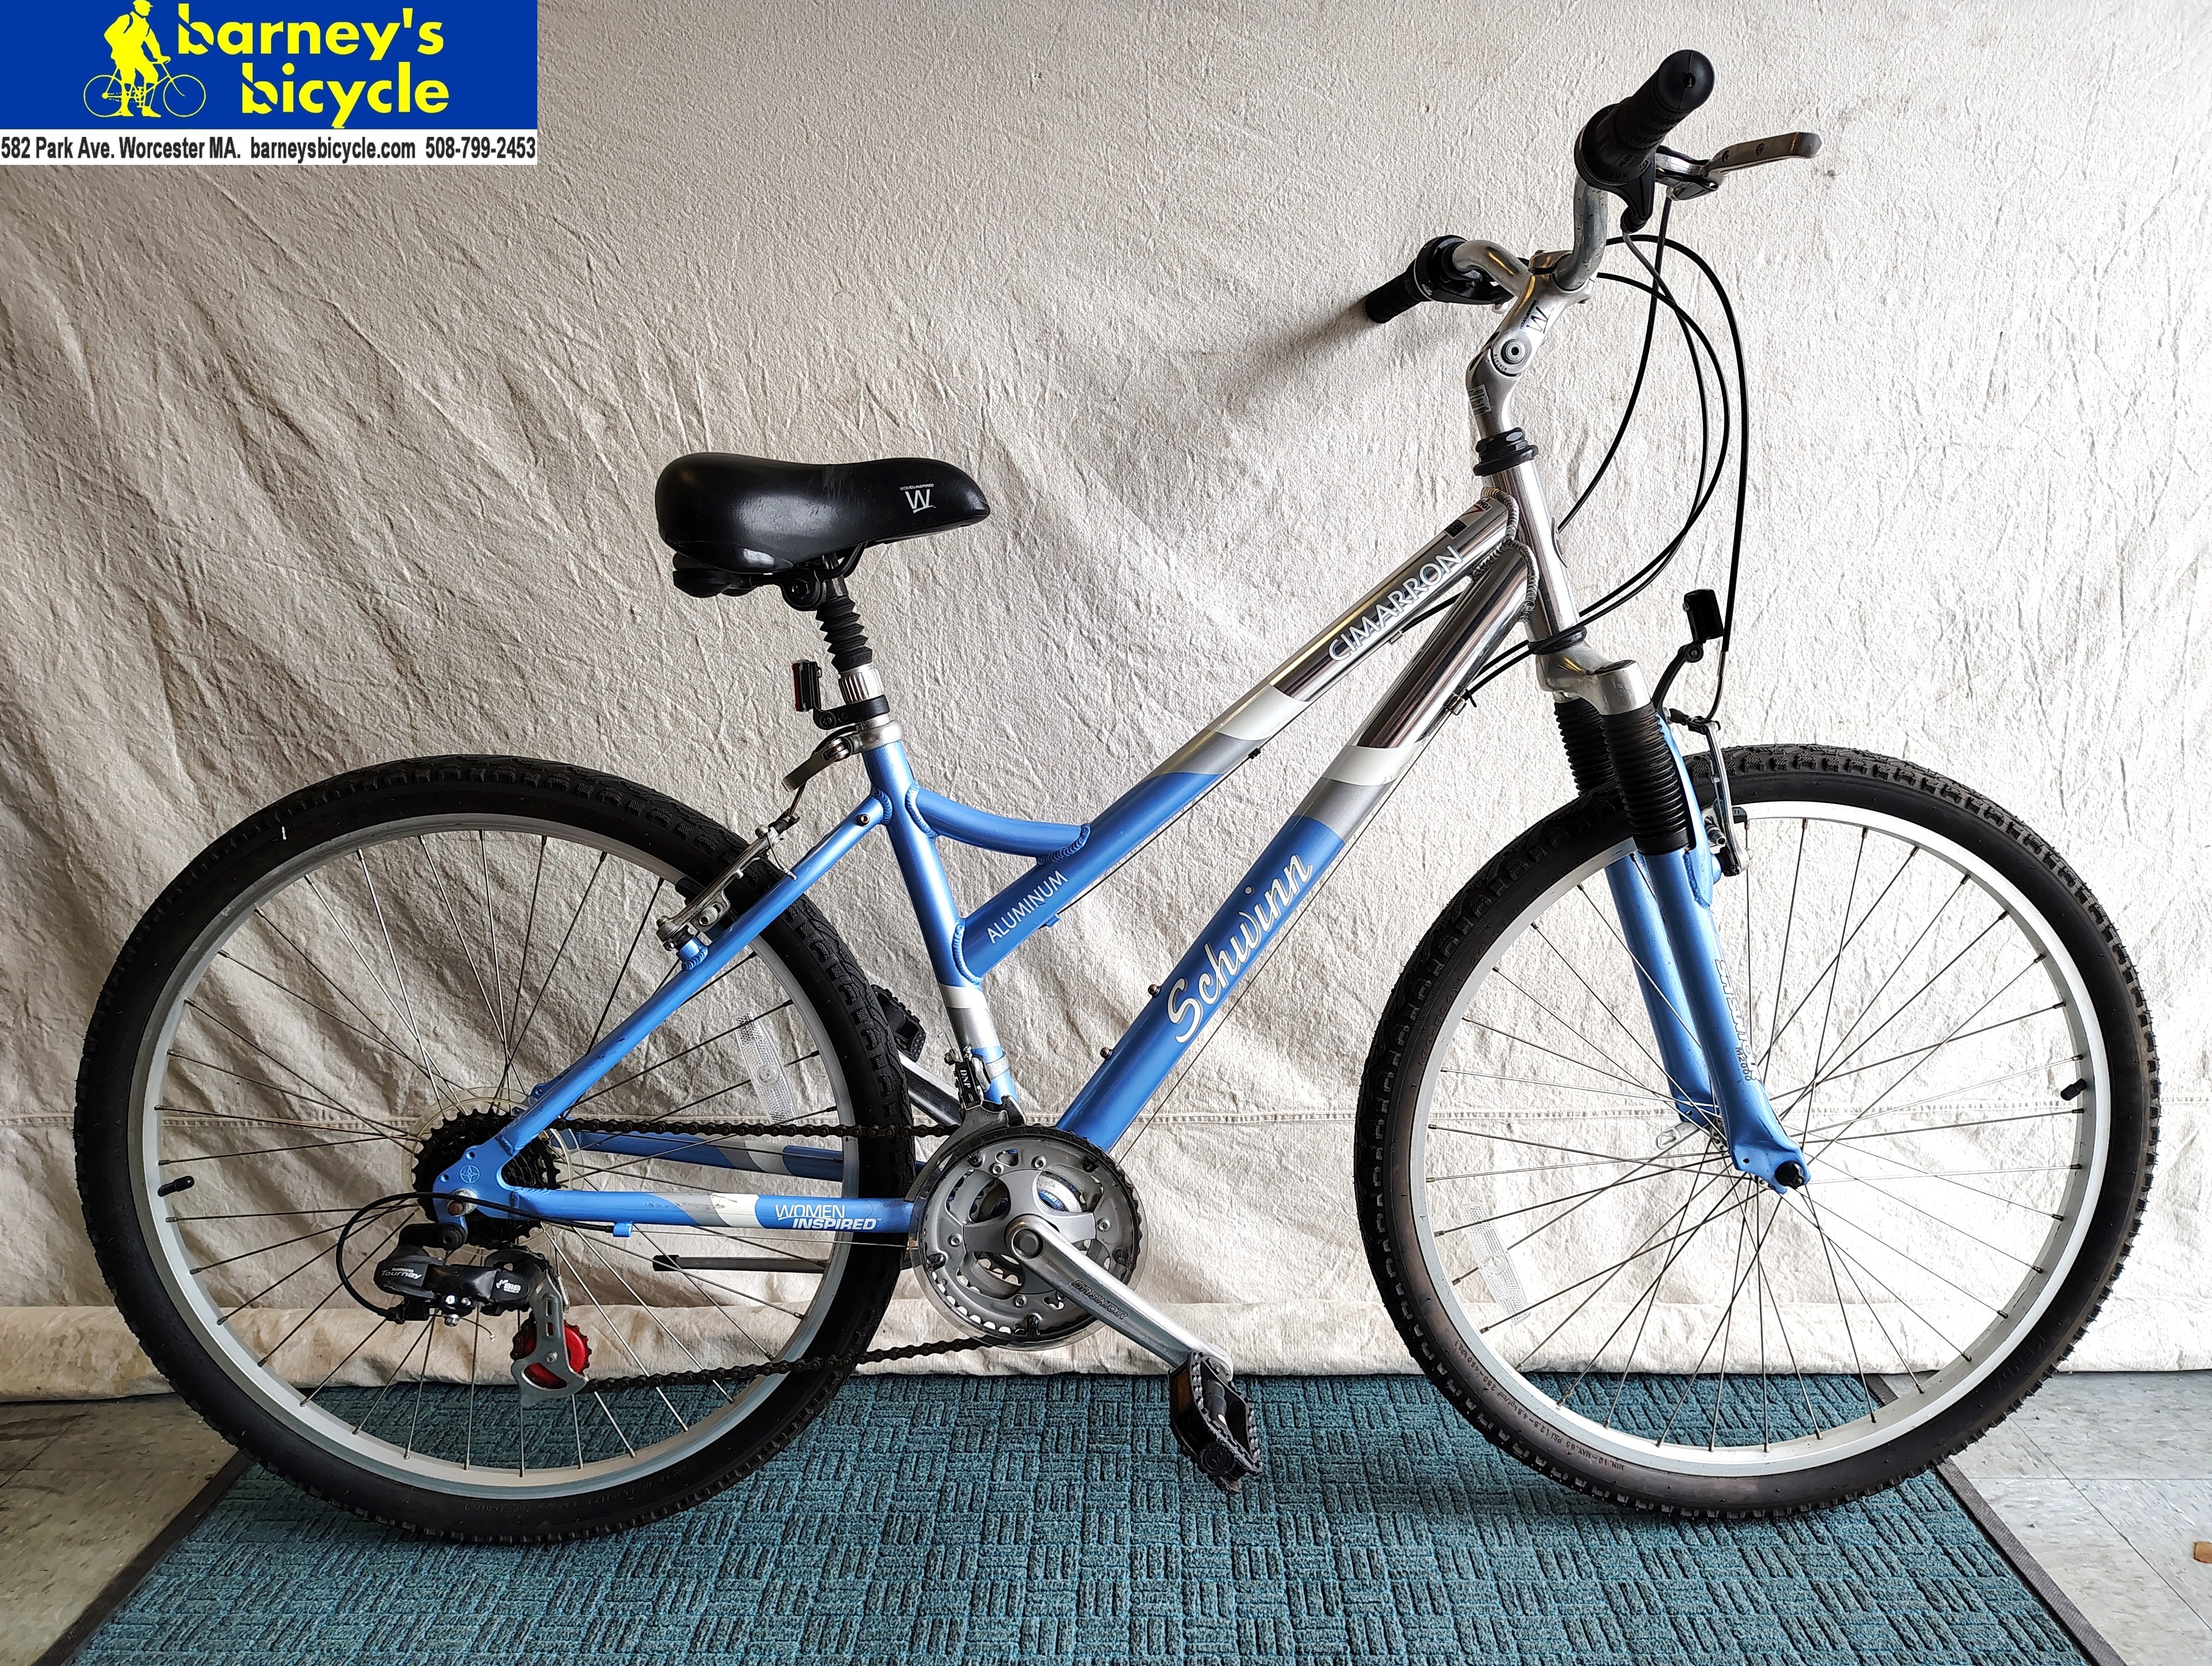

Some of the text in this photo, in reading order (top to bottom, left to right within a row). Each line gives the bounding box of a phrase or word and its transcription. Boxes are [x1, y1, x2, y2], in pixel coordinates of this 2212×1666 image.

[1328, 544, 1464, 662] CIMARRON
[987, 870, 1068, 944] ALUMINUM
[1166, 854, 1313, 1043] Schwinn
[960, 1069, 971, 1088] DNP
[1734, 1046, 1752, 1081] M2000
[775, 1204, 846, 1219] WOMEN
[792, 1218, 877, 1230] INSPIRED
[1088, 1291, 1129, 1320] SUNTOUR
